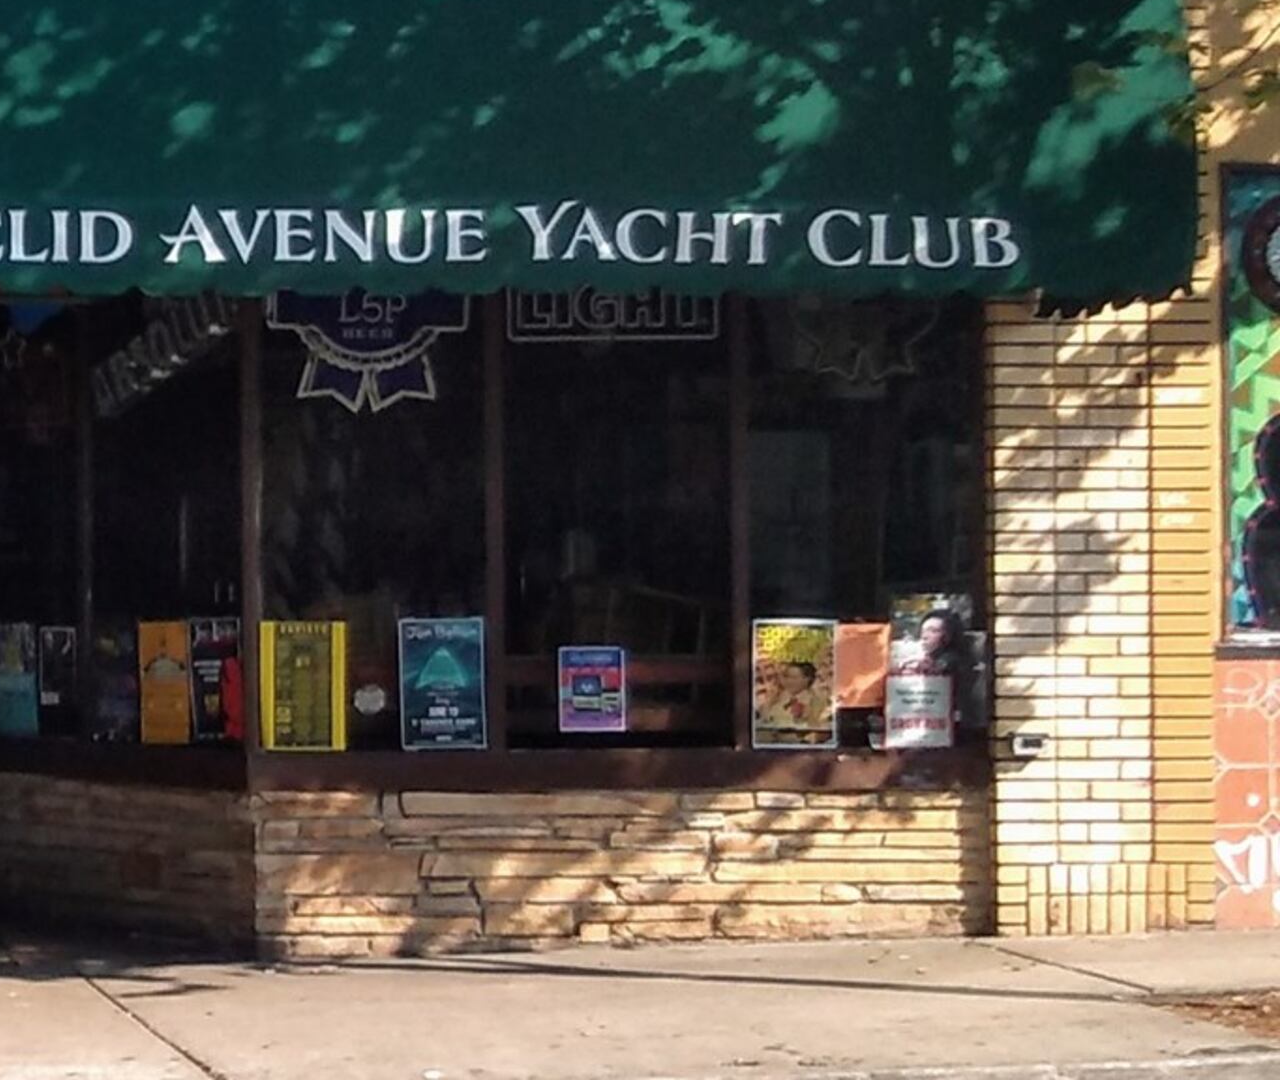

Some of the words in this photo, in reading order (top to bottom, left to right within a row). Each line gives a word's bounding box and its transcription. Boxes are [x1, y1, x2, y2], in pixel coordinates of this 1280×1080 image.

[158, 204, 487, 264] AVENUE
[514, 200, 783, 265] YACHT
[807, 208, 1022, 270] CLUB
